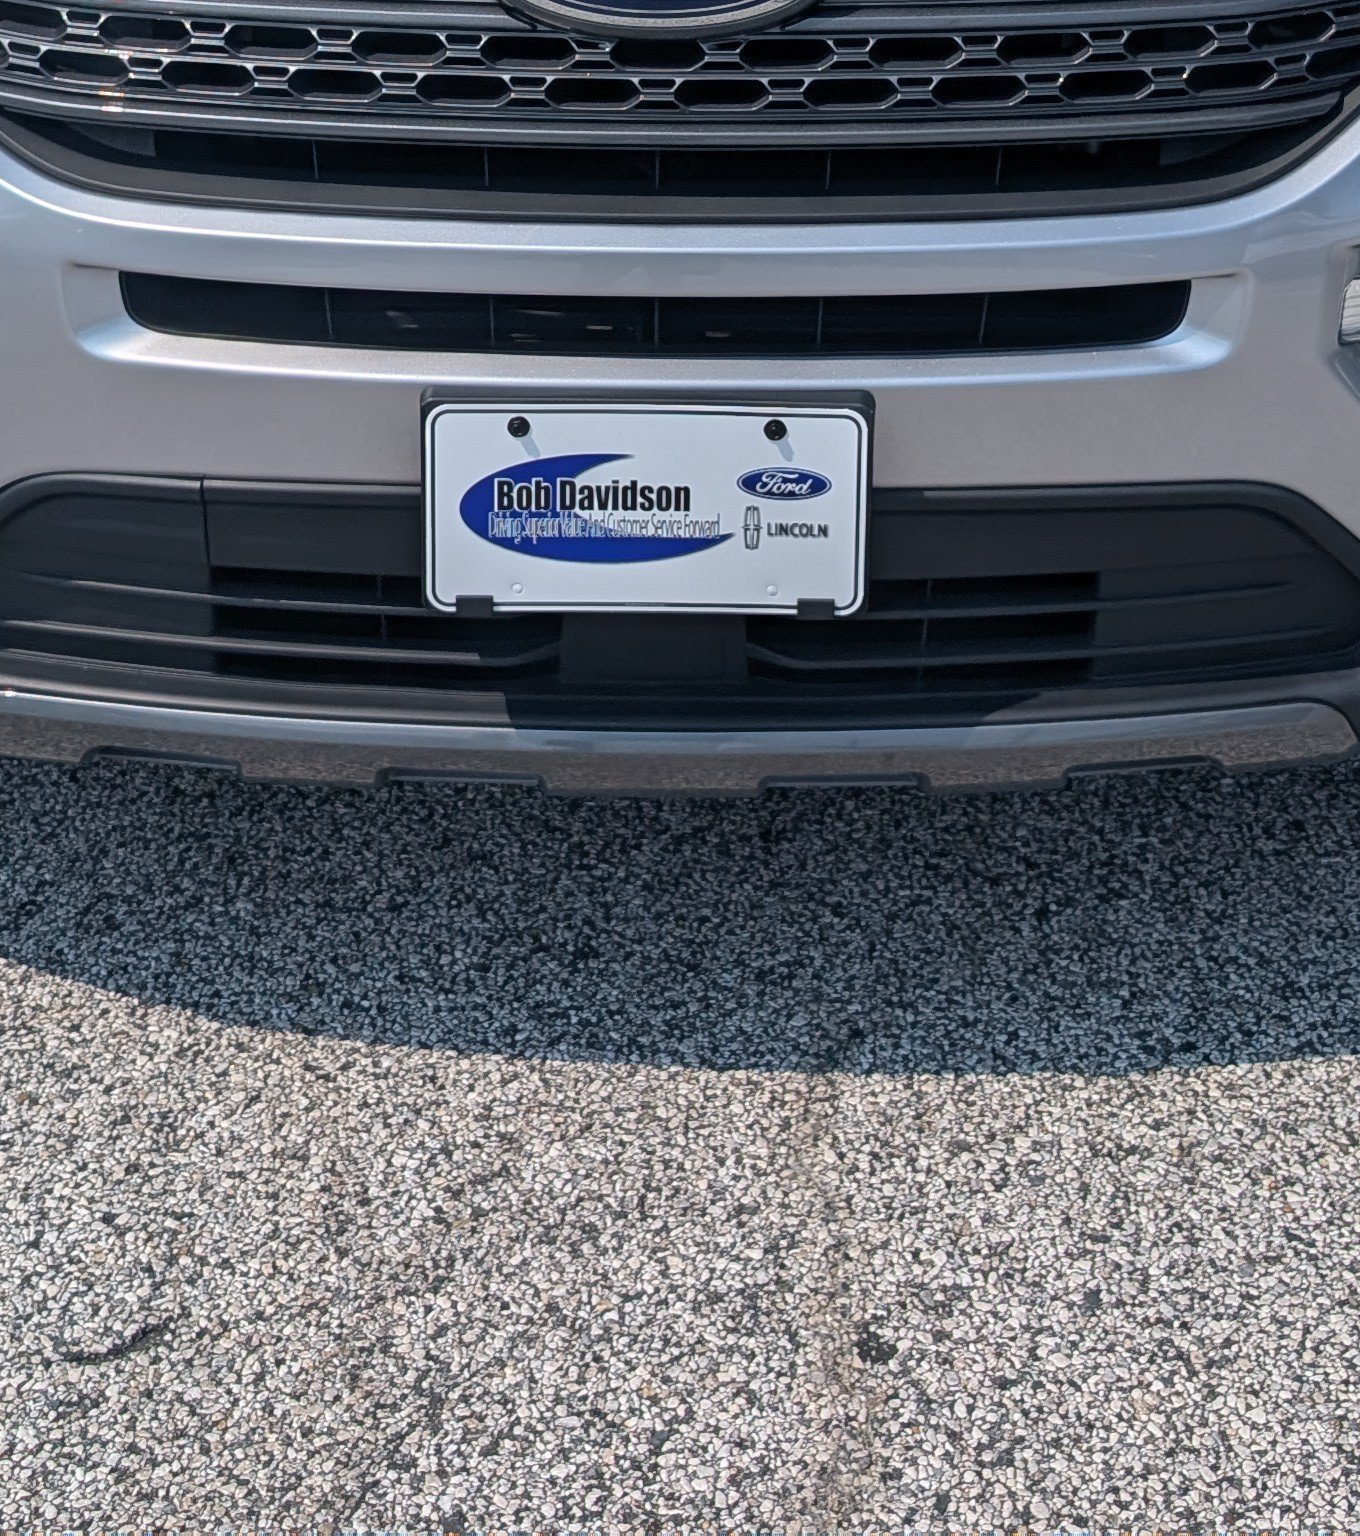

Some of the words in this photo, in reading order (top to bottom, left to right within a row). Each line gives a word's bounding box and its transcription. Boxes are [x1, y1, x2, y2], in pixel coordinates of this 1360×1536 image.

[496, 478, 551, 512] Bob
[558, 479, 691, 512] Davidson
[755, 472, 813, 494] Ford
[488, 511, 521, 544] Driving
[522, 511, 559, 544] Superior
[560, 511, 586, 537] Value
[585, 512, 606, 537] And
[607, 512, 650, 537] Customer
[651, 512, 682, 537] Service
[684, 512, 720, 538] Forward
[766, 522, 829, 538] LINCOLN
